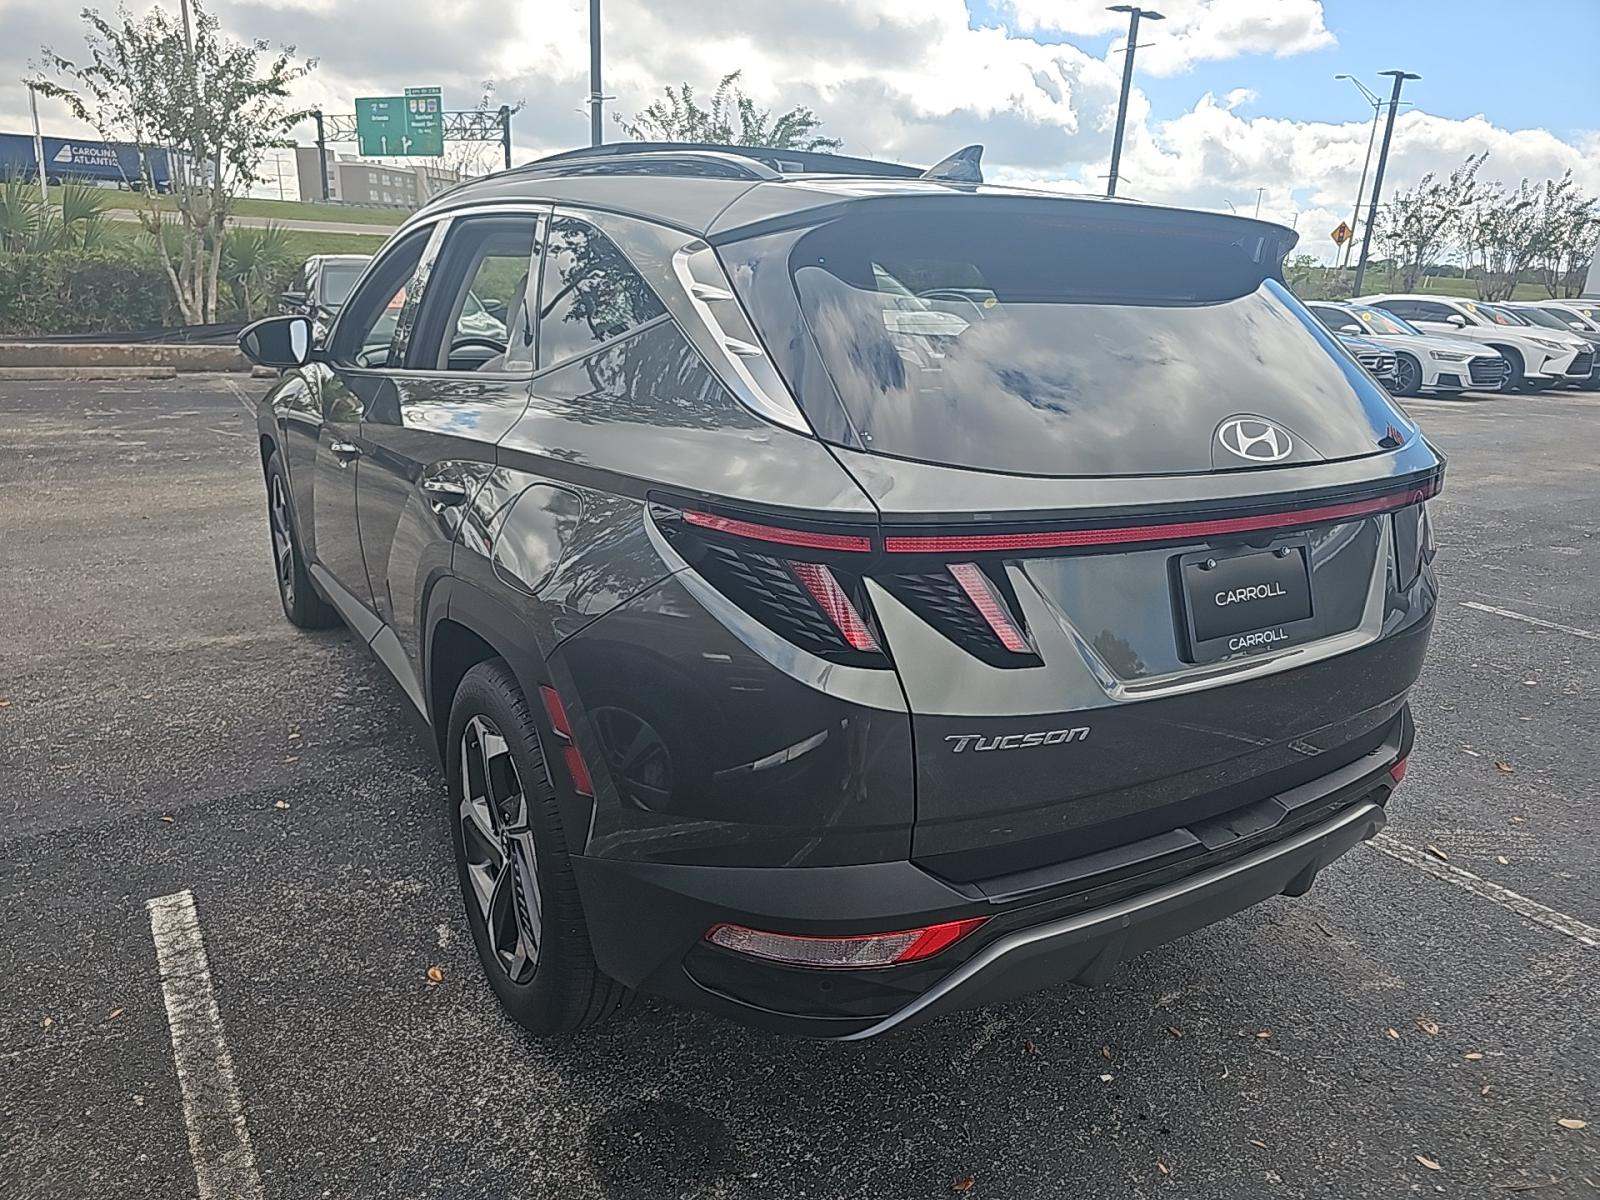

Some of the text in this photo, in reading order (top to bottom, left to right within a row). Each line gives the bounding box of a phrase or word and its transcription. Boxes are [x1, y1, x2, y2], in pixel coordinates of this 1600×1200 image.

[72, 146, 117, 158] CAROLINA
[73, 156, 119, 167] ATLANTIC
[1215, 582, 1286, 606] CARROLL
[1228, 628, 1288, 651] CARROLL
